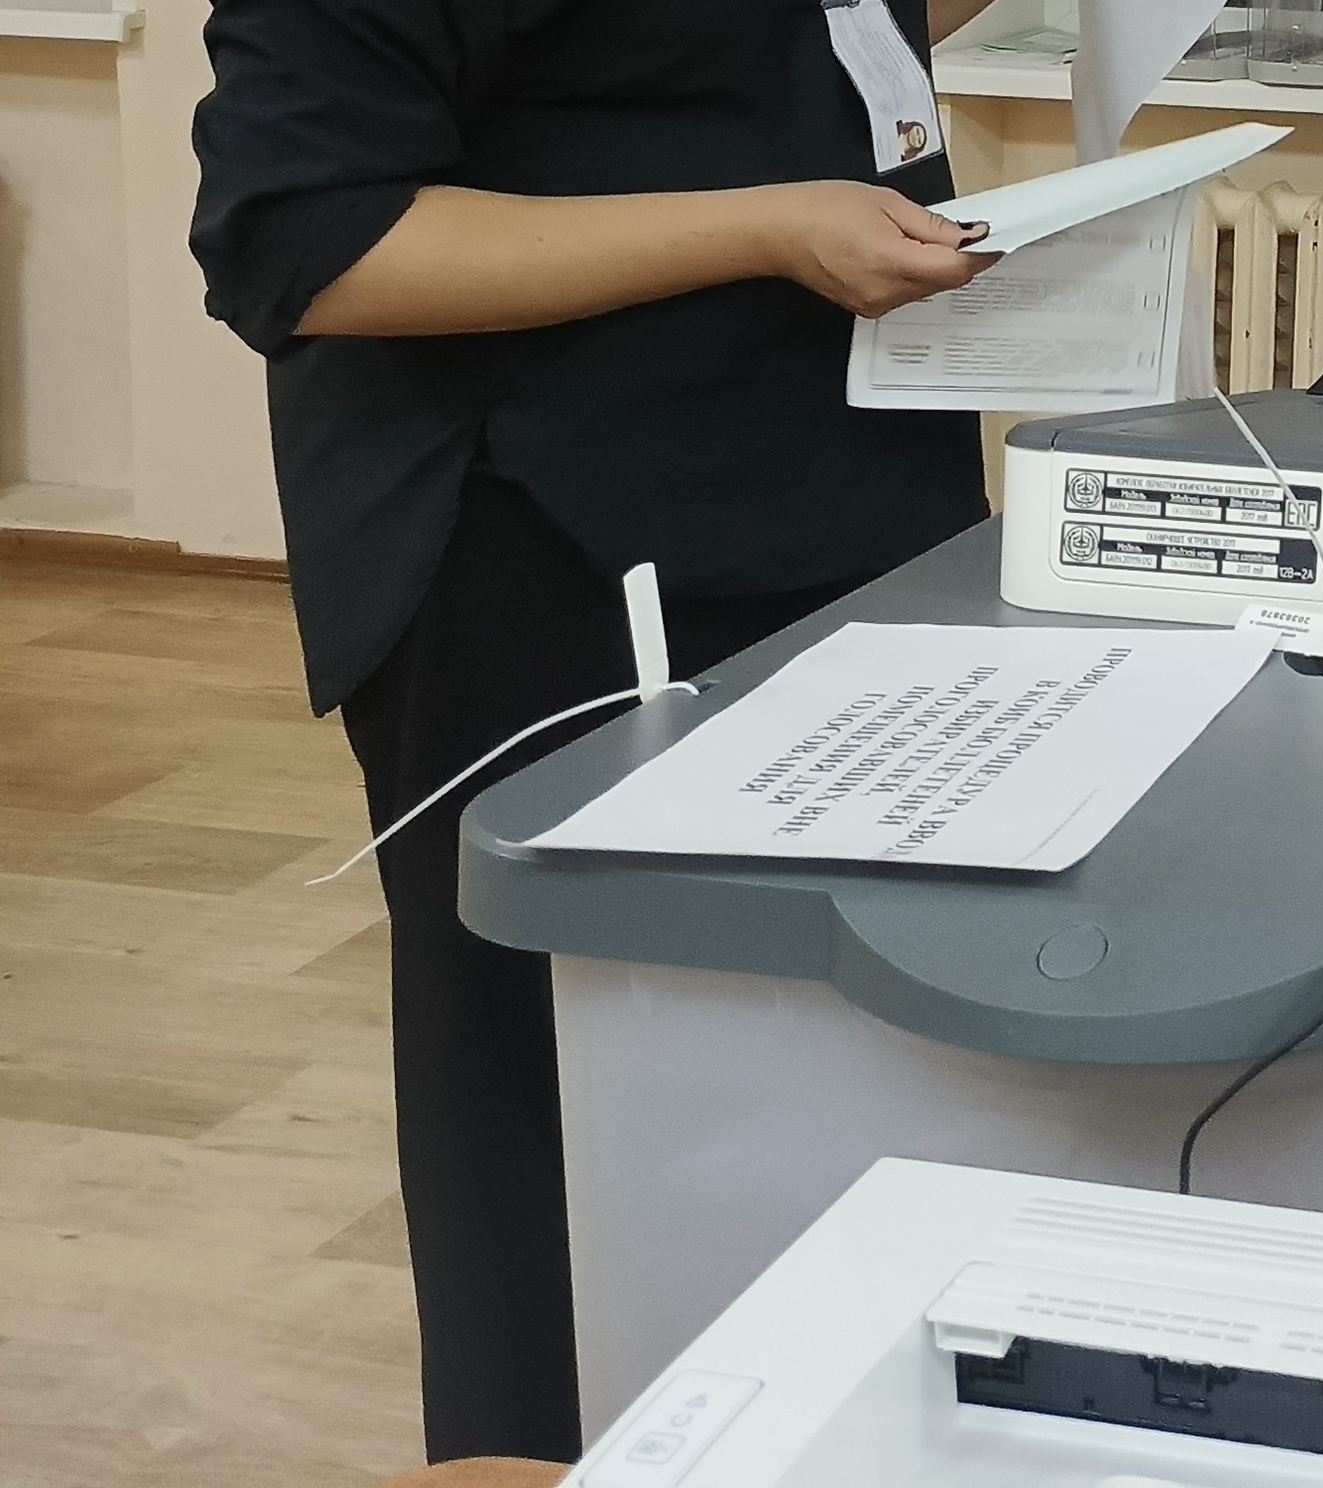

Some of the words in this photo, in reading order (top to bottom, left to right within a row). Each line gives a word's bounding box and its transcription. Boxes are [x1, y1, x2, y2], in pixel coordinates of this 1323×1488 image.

[994, 689, 1050, 727] КОИБ
[1027, 647, 1133, 731] ПРОВОДИТСЯ
[1035, 679, 1062, 689] В
[738, 692, 888, 793] ГОЛОСОВАНИЯ
[808, 685, 937, 773] ПОМЕЩЕНИЯ
[814, 666, 1000, 802] ПРОГОЛОСОВАВШИХ
[859, 699, 1000, 797] ИЗБИРАТЕЛЕЙ,
[765, 774, 823, 805] ДЛЯ
[876, 726, 1008, 826] БЮЛЛЕТЕНЕЙ
[930, 732, 1043, 816] ПРОЦЕДУРА
[773, 805, 830, 837] ВНЕ
